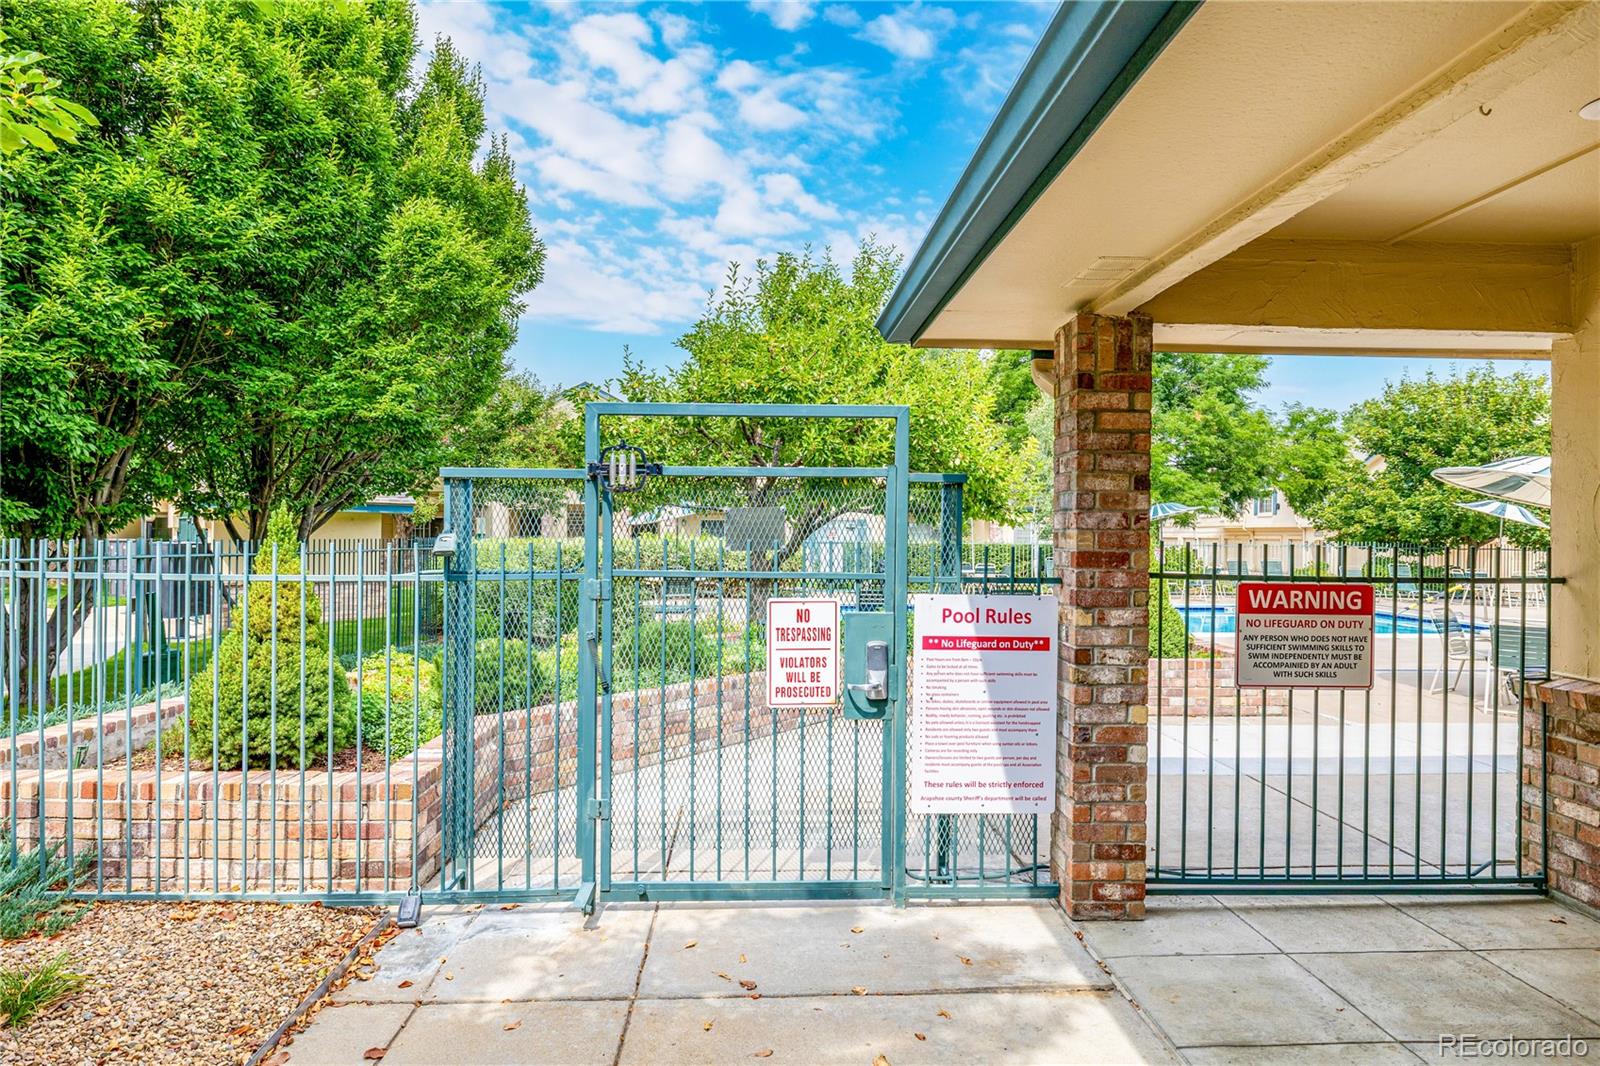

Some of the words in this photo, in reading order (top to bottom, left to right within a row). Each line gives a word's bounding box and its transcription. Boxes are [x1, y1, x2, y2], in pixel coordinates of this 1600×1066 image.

[1248, 589, 1362, 610] WARNING
[796, 608, 810, 623] NO
[942, 607, 980, 624] Pool
[986, 607, 1032, 625] Rules
[1245, 619, 1262, 628] NO
[1264, 619, 1318, 628] LIFEGUARD
[1320, 620, 1335, 629] ON
[1337, 620, 1364, 629] DUTY
[775, 627, 832, 642] TRESPASSING
[1242, 634, 1259, 642] ANY
[1260, 634, 1289, 642] PERSON
[1330, 635, 1348, 643] NOT
[941, 639, 953, 648] No
[956, 638, 997, 650] Lifeguard
[998, 640, 1010, 648] on
[1246, 643, 1286, 651] SUFFICIENT
[1330, 644, 1353, 652] SKILLS
[1355, 644, 1365, 652] TO
[779, 656, 827, 668] VIOLATORS
[1247, 652, 1270, 660] SWIM
[1330, 653, 1352, 661] MUST
[1334, 662, 1358, 670] ADULT
[785, 671, 806, 683] WILL
[810, 671, 821, 683] BE
[775, 686, 832, 698] PROSECUTED
[924, 780, 944, 788] These
[945, 780, 963, 788] rules
[964, 780, 977, 788] will
[978, 780, 987, 788] be
[988, 780, 1012, 789] strictly
[1013, 781, 1044, 789] enforced
